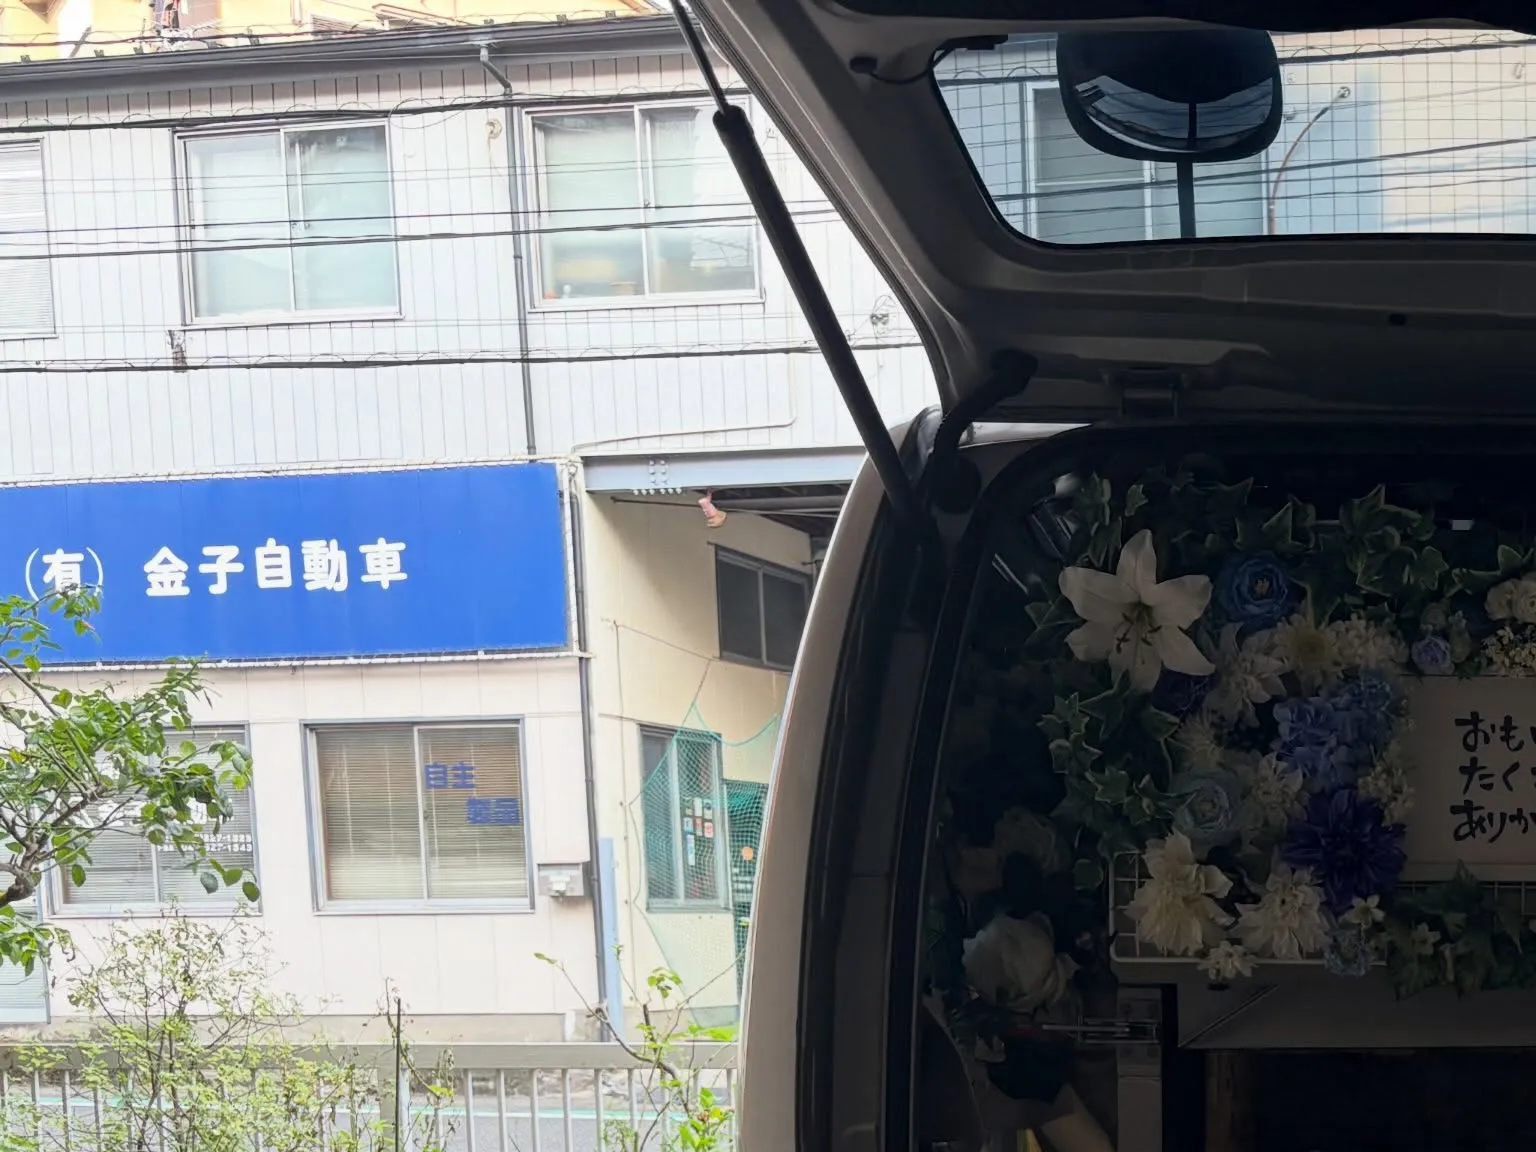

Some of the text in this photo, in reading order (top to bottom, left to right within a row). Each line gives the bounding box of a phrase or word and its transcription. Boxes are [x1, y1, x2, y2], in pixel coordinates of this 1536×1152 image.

[143, 537, 408, 597] 金子自動車
